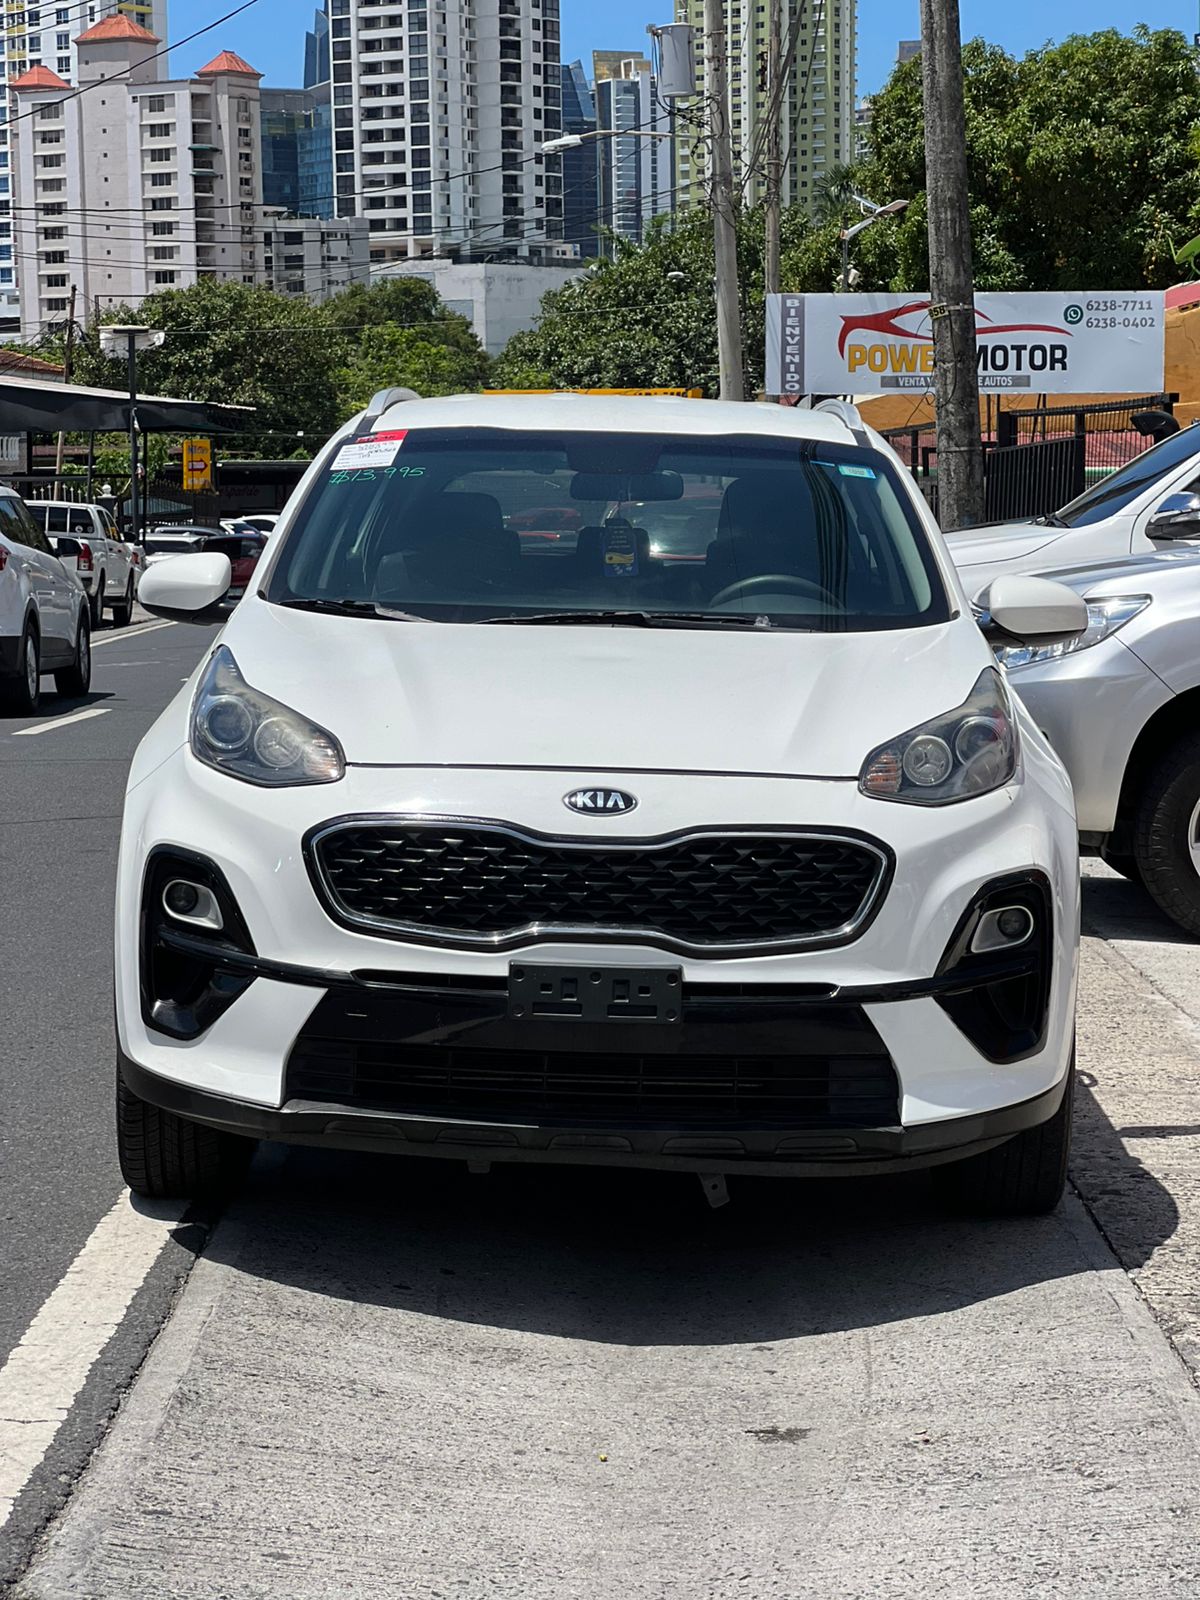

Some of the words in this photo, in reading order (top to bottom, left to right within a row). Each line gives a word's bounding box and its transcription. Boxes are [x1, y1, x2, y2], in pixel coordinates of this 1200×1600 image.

[1086, 300, 1153, 312] 6238-7711
[1086, 317, 1156, 329] 6238-0402
[785, 299, 800, 391] BIENVENIDO
[848, 344, 935, 373] POWE
[898, 376, 926, 387] VENTA
[984, 376, 1013, 387] AUTOS
[576, 791, 626, 809] KIA
